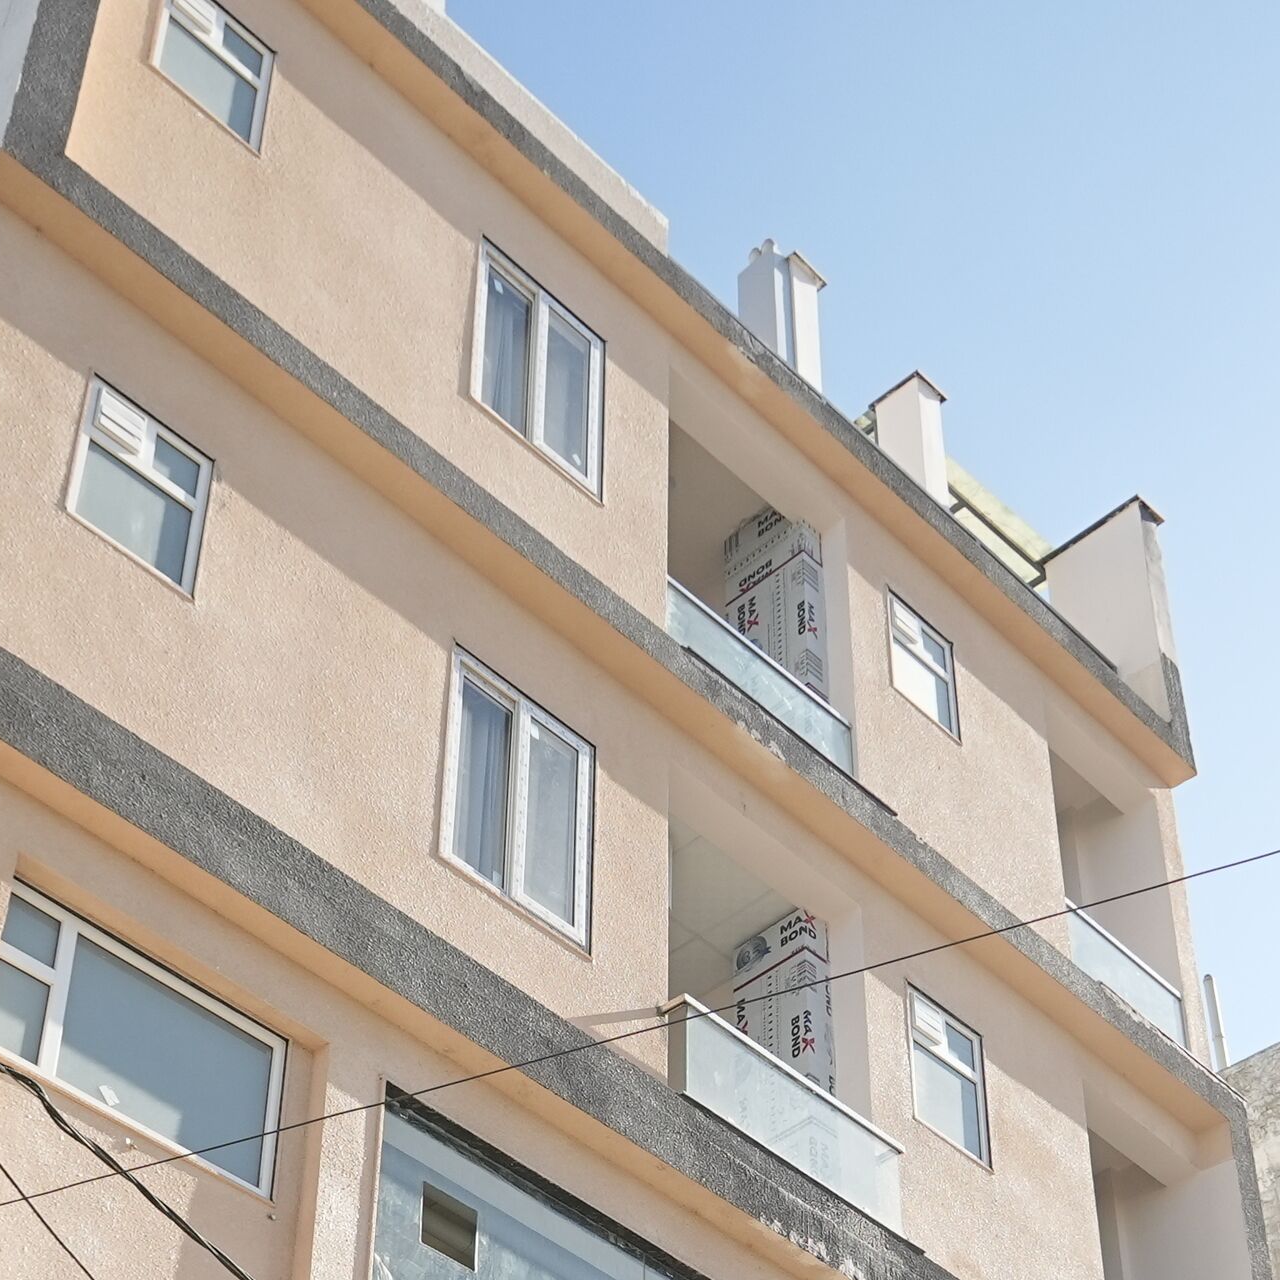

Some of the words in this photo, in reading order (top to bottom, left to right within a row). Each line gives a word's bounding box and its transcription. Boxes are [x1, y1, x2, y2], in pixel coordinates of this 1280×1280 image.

[738, 559, 773, 588] BOND
[747, 595, 760, 633] MAX
[797, 600, 806, 635] BOND
[780, 908, 817, 935] MAX
[780, 925, 817, 947] BOND
[791, 1015, 801, 1058] BOND
[803, 1009, 816, 1053] MAX
